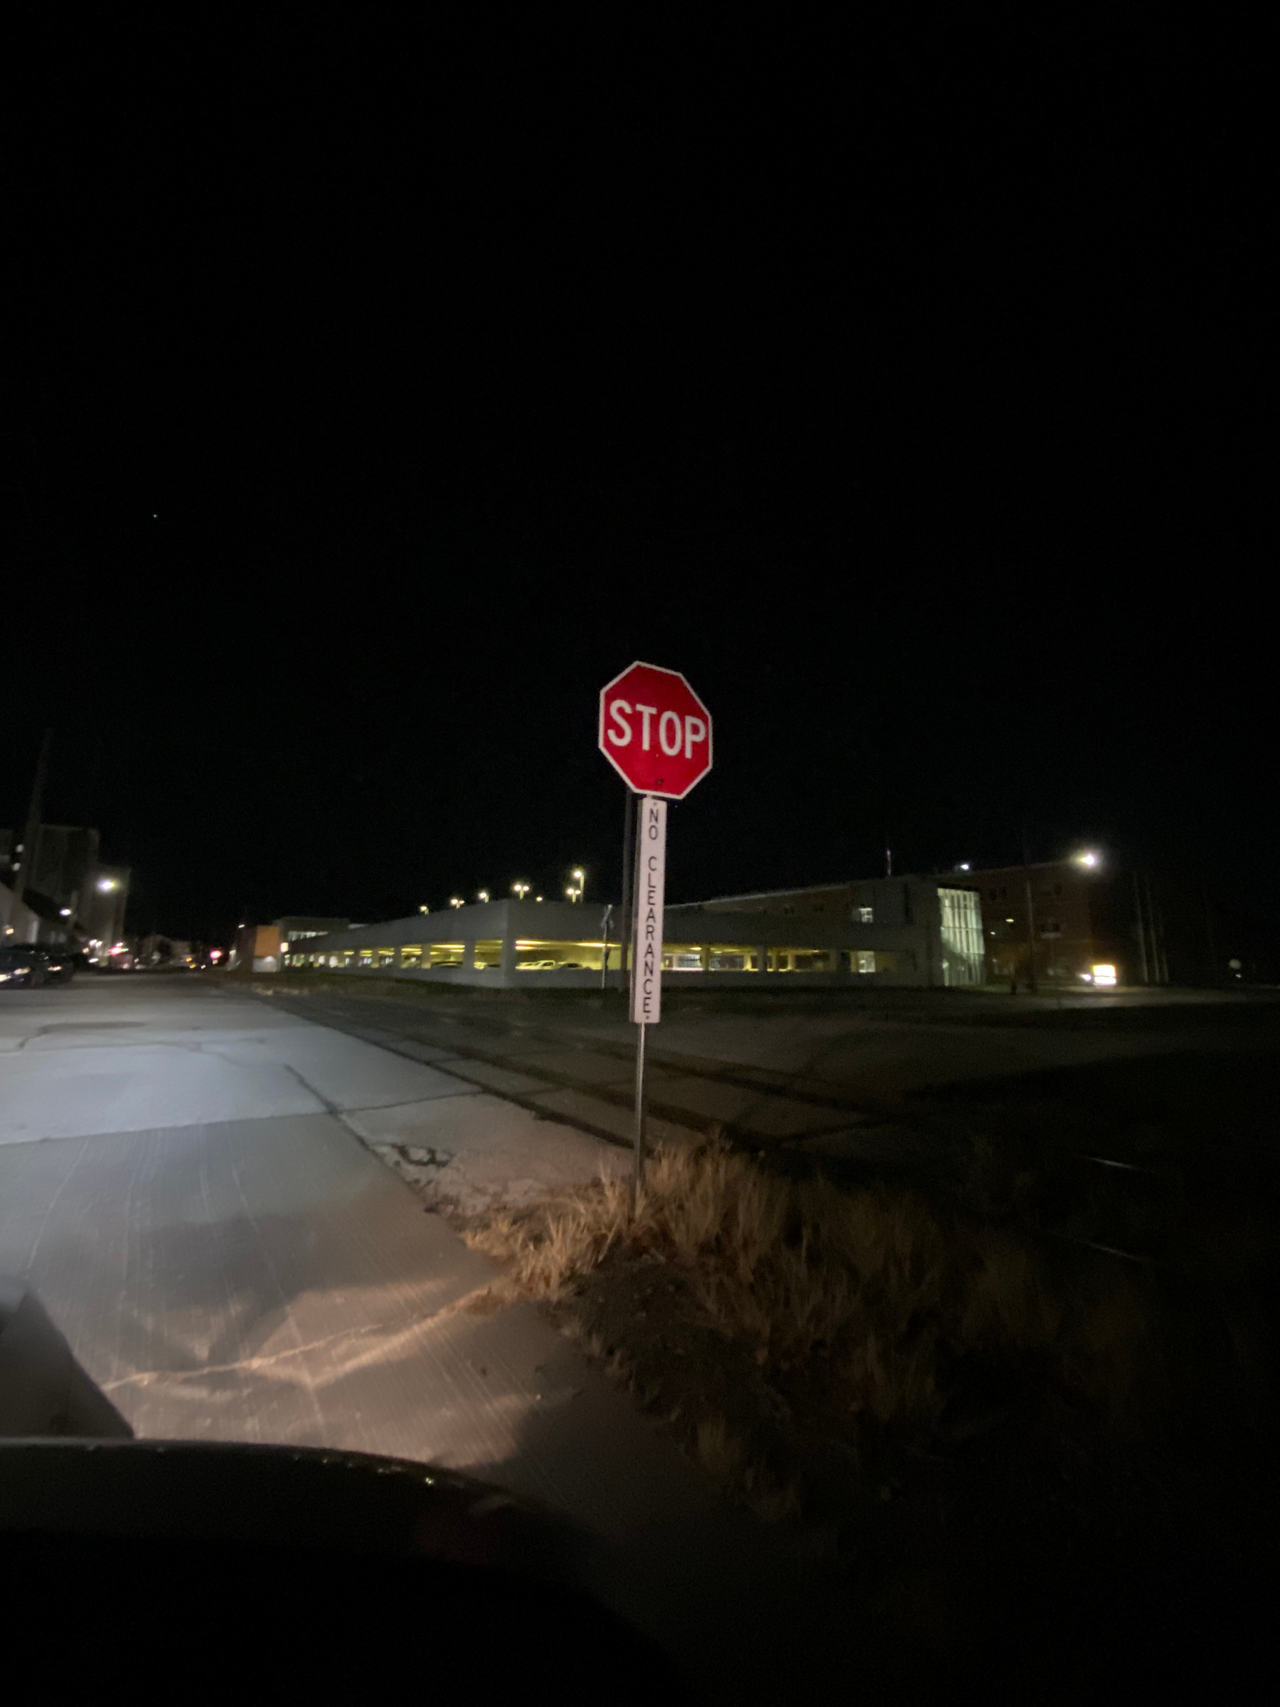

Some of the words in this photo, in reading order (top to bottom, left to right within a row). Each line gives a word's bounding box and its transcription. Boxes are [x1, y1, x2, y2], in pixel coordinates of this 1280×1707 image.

[607, 699, 707, 760] STOP
[648, 808, 659, 841] NO
[643, 856, 658, 1014] CLEARANCE
